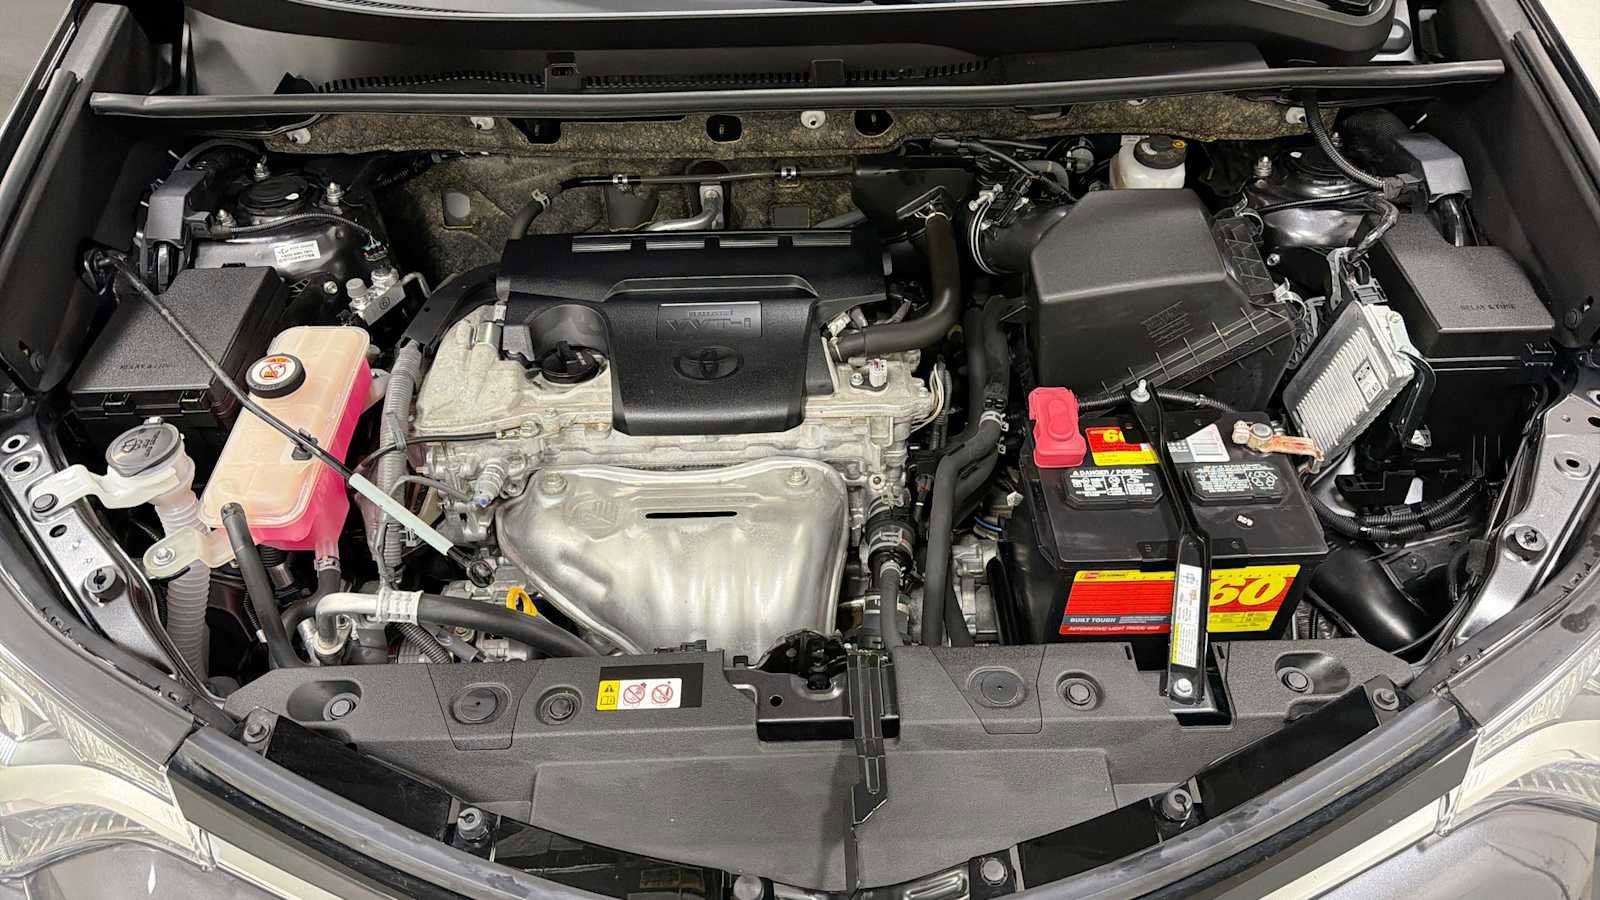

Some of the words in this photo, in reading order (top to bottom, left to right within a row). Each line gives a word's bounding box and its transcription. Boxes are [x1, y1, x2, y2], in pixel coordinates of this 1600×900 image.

[1080, 469, 1110, 477] DANGER
[1117, 468, 1144, 476] POISON
[1210, 577, 1287, 606] 60
